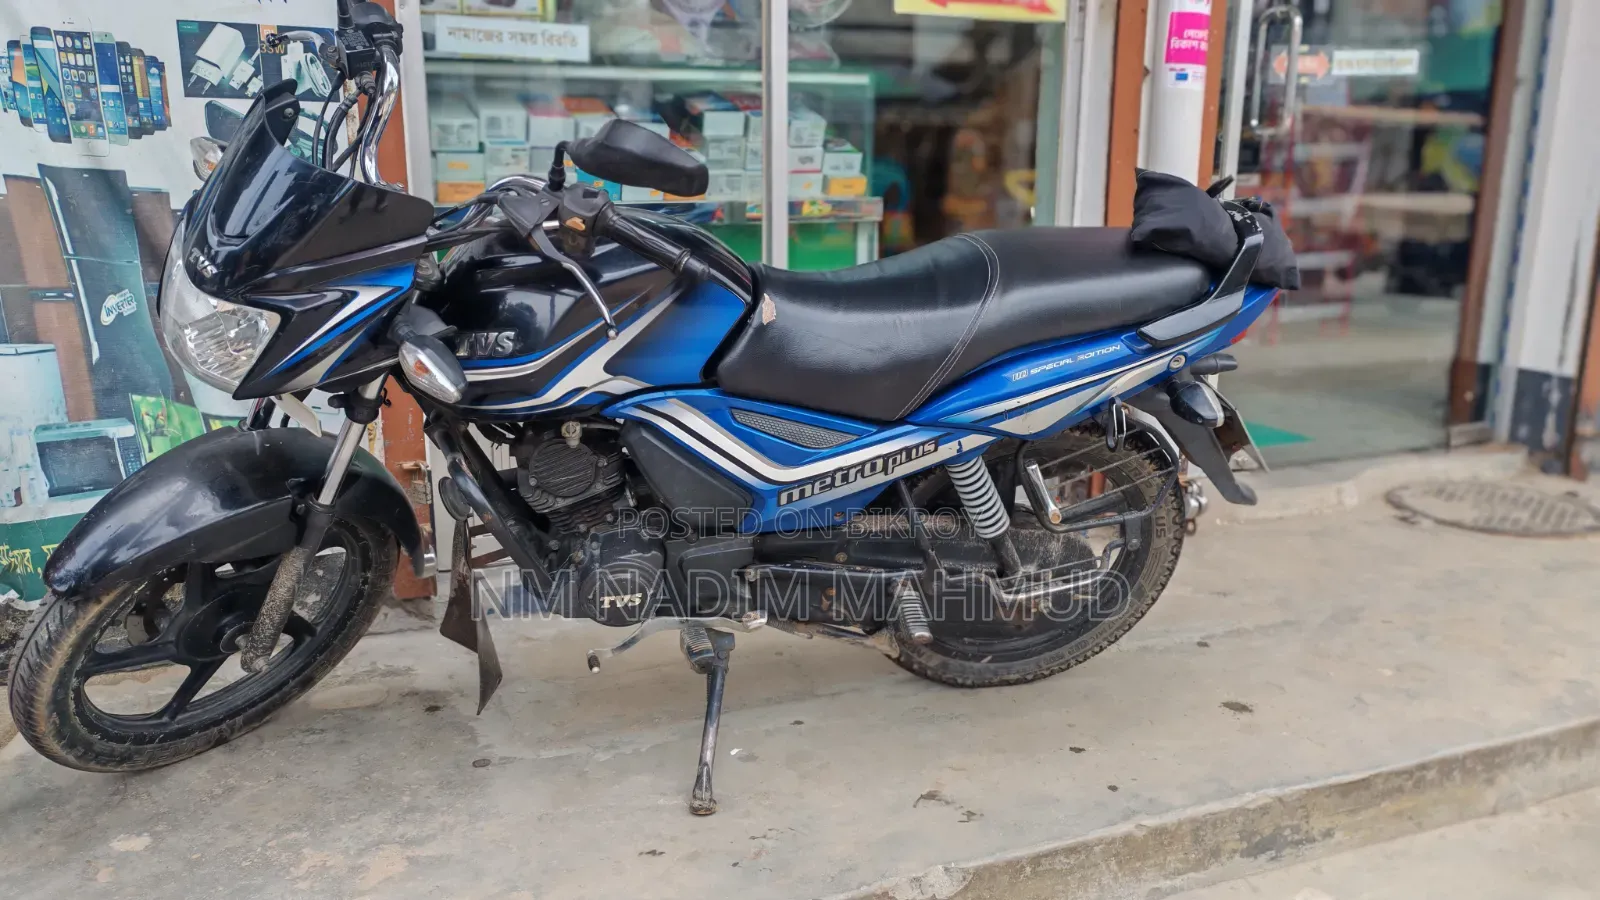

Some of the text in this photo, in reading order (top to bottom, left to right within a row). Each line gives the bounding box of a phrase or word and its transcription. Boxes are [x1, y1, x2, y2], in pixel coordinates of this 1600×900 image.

[447, 26, 504, 44] নামাজের
[541, 28, 579, 48] বিরতি
[189, 246, 218, 279] TVS
[456, 331, 516, 357] TVS
[1030, 357, 1075, 376] SPECIAL
[599, 592, 643, 609] TVS
